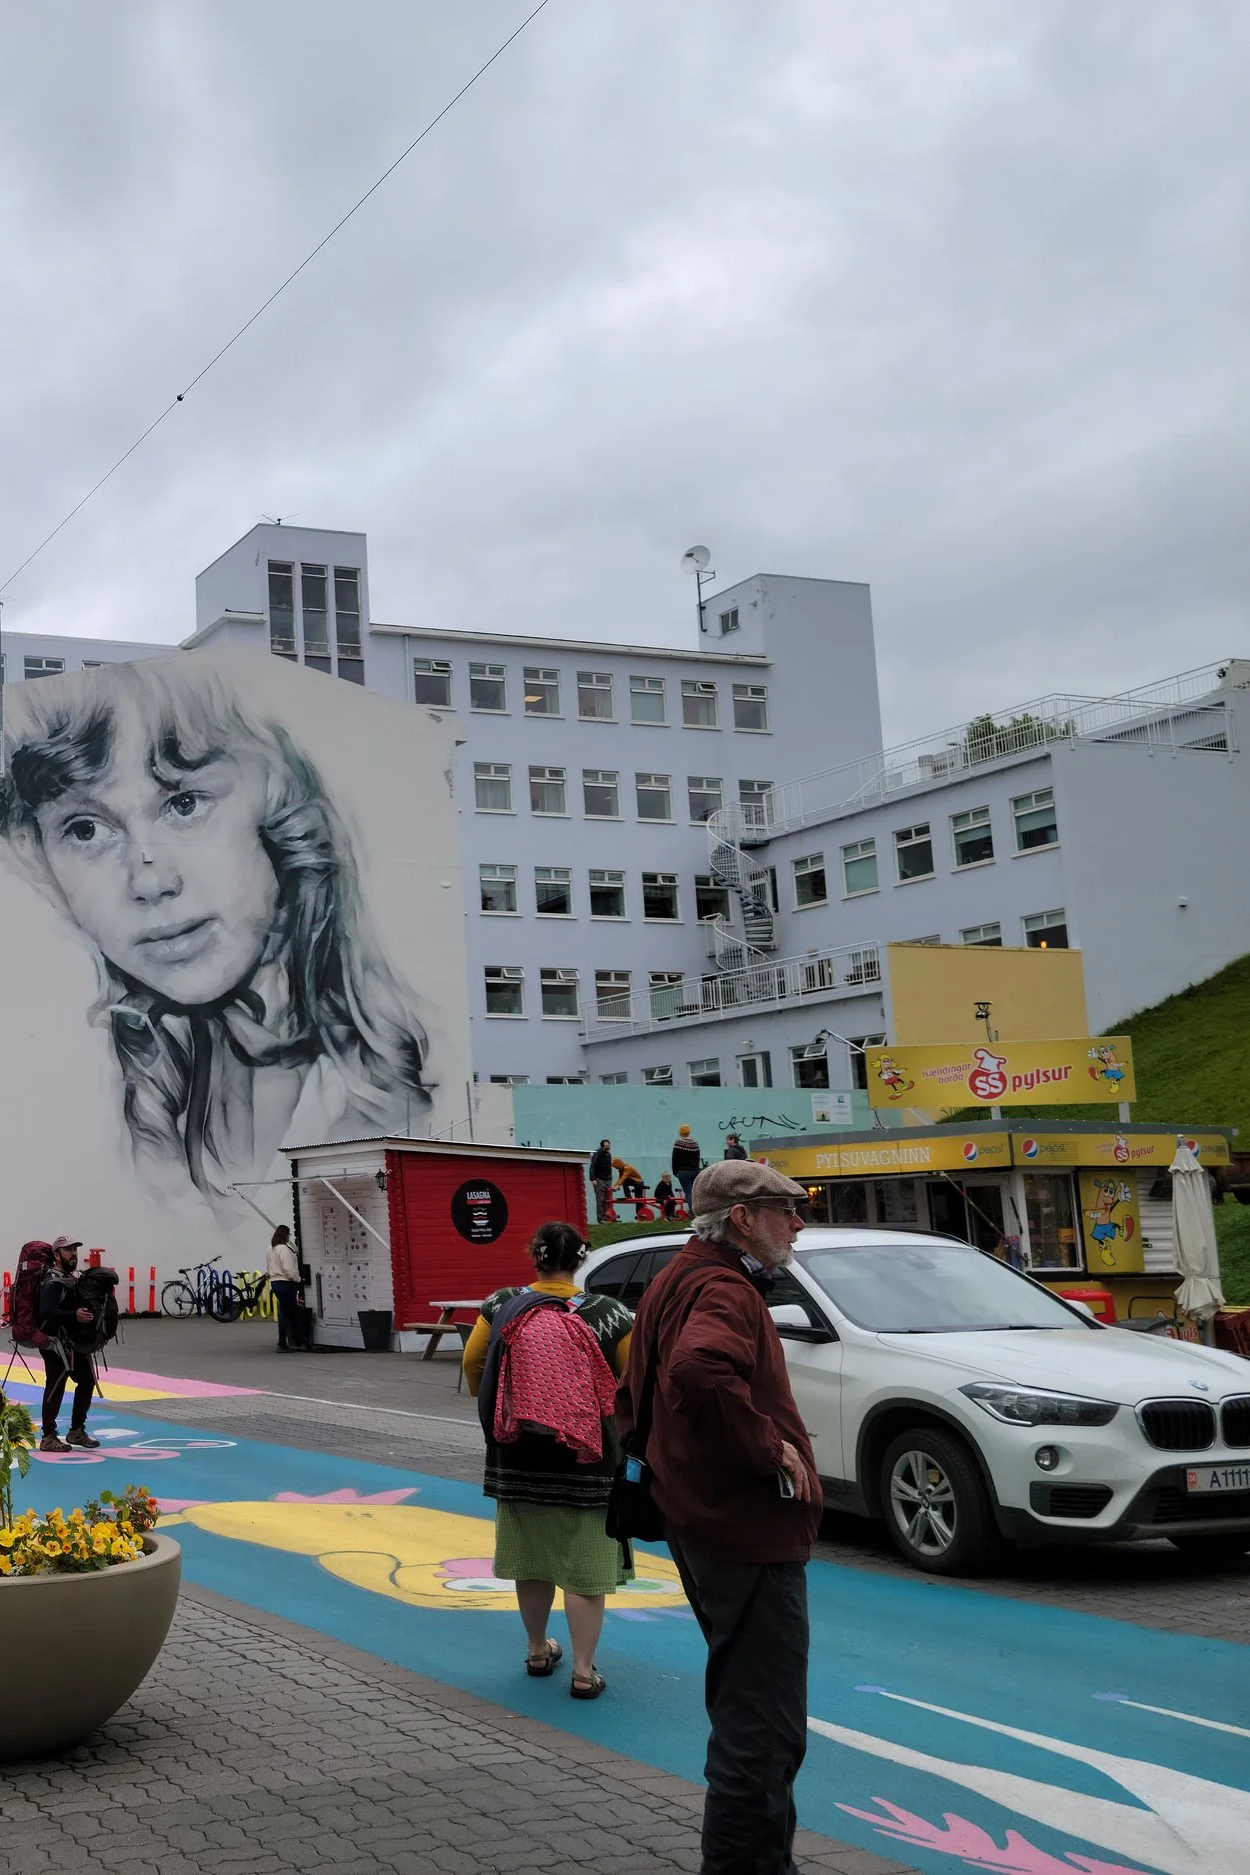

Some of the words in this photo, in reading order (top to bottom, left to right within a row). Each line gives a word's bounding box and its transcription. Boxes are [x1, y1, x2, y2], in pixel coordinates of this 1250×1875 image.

[1012, 1066, 1072, 1092] pylsur
[815, 1147, 930, 1169] PYLSUVAGNINN
[1131, 1146, 1155, 1159] pylsur
[467, 1191, 491, 1200] LASAGNA
[1210, 1468, 1250, 1488] A1111
